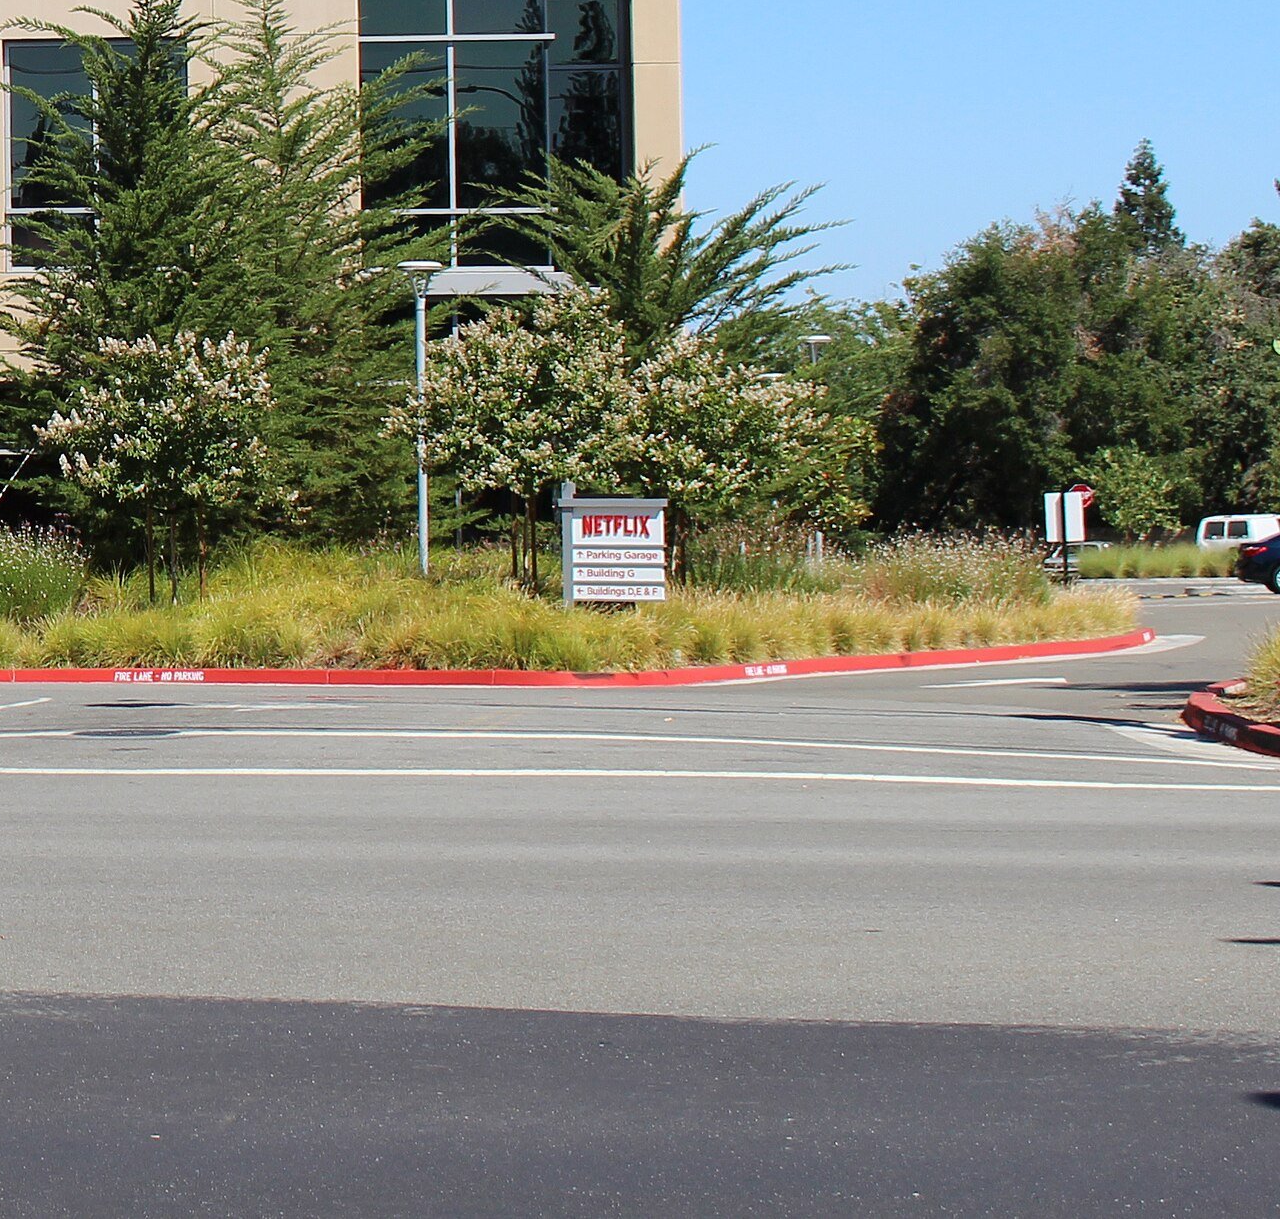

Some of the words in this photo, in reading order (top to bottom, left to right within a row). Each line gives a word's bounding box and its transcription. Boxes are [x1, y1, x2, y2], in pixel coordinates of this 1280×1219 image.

[581, 514, 651, 538] NETFLIX
[586, 550, 622, 561] Parking
[623, 551, 658, 560] Garage
[586, 568, 625, 579] Building
[627, 569, 635, 578] G
[586, 587, 626, 597] Buildings
[643, 587, 650, 596] &
[652, 587, 658, 595] F
[114, 671, 132, 682] FIRE
[133, 671, 153, 682] LANE
[160, 671, 172, 681] NO
[173, 671, 205, 681] PARKING
